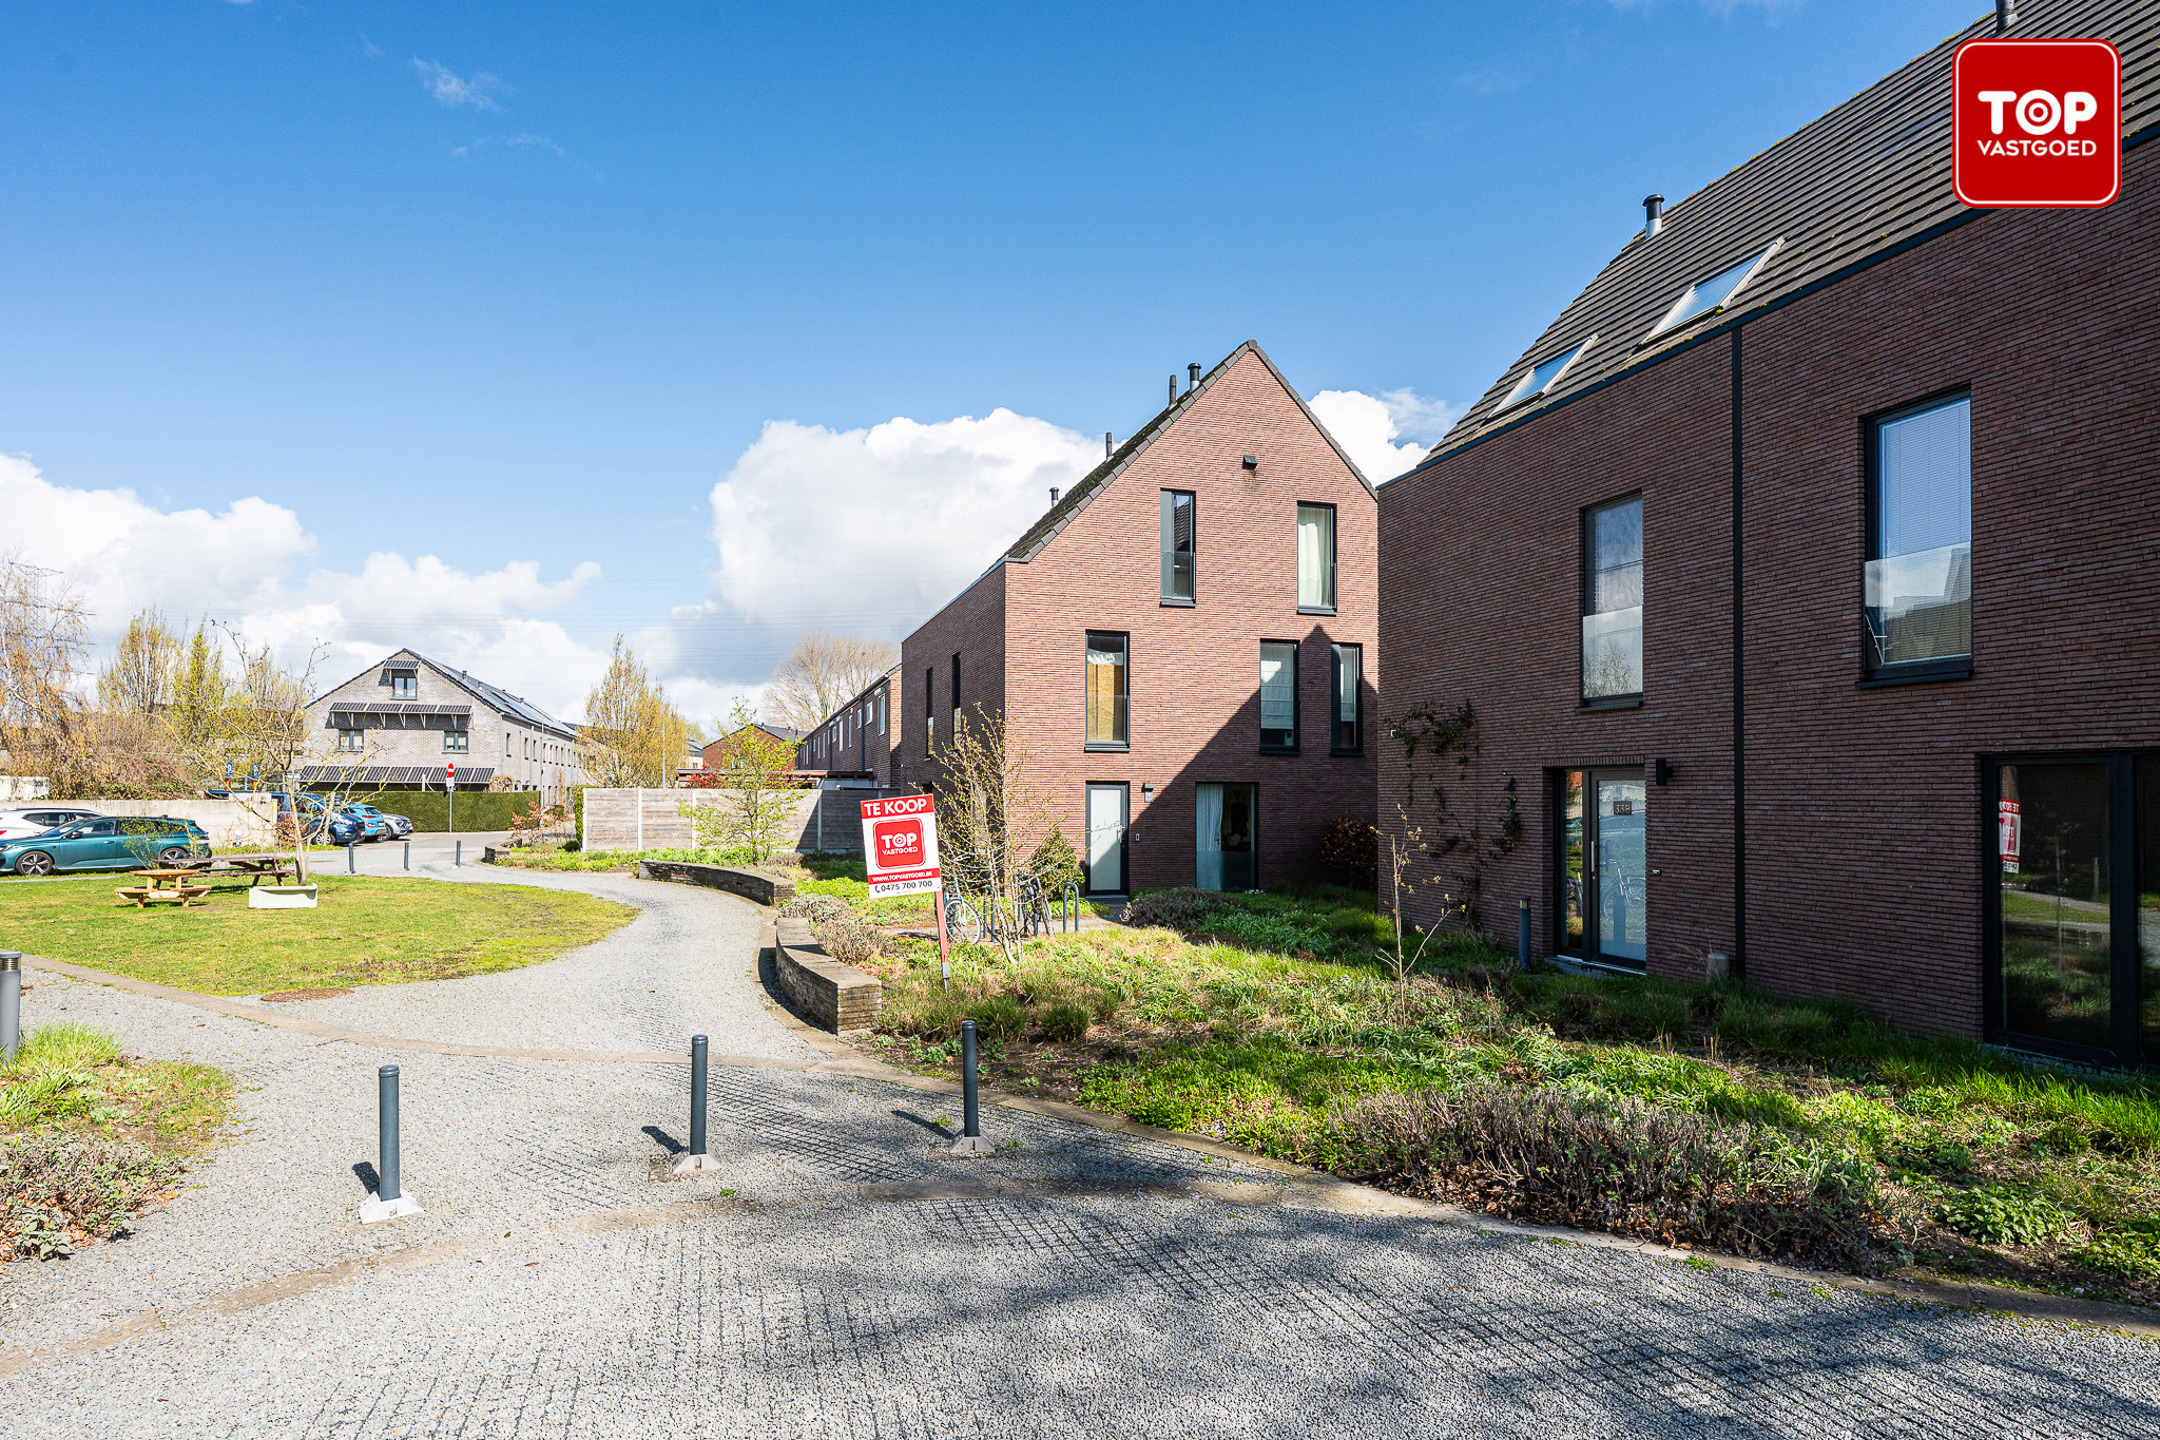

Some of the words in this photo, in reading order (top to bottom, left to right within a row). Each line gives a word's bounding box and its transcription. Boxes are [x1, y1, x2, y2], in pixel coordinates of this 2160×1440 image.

[864, 802, 882, 816] TE
[884, 798, 927, 815] KOOP
[881, 832, 917, 848] TOP
[881, 846, 918, 856] VASTGOED
[872, 871, 933, 882] WWW.TOPVASTGOED.BE
[880, 883, 900, 892] 0475
[901, 882, 916, 890] 700
[918, 880, 933, 888] 700
